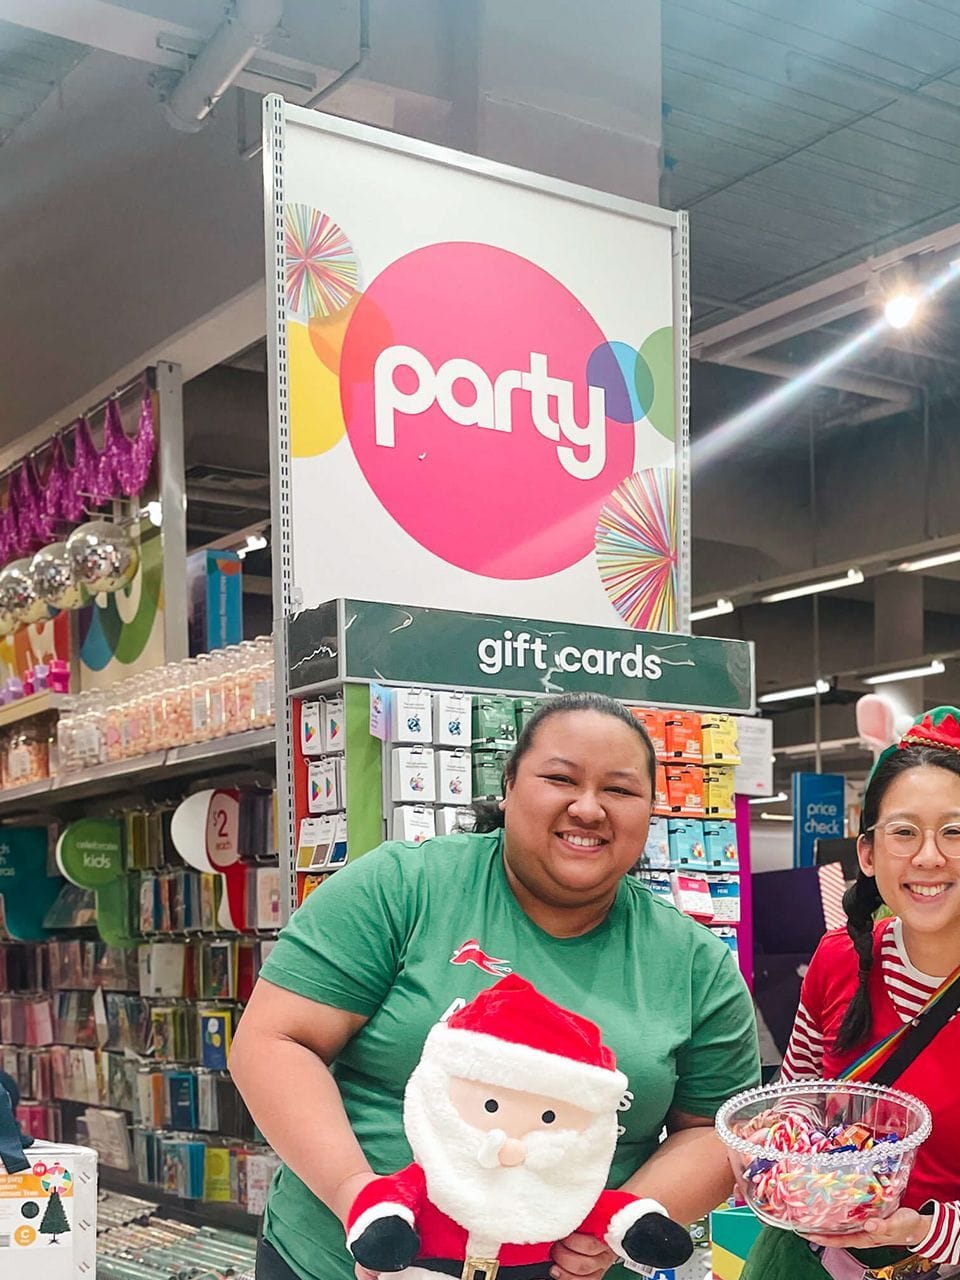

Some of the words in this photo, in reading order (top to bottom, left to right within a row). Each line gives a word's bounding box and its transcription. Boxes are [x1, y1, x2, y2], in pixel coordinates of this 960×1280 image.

[374, 345, 607, 481] party
[478, 630, 547, 674] gift
[559, 644, 662, 680] cards
[806, 802, 837, 822] price
[804, 817, 840, 835] check
[83, 852, 111, 869] kids
